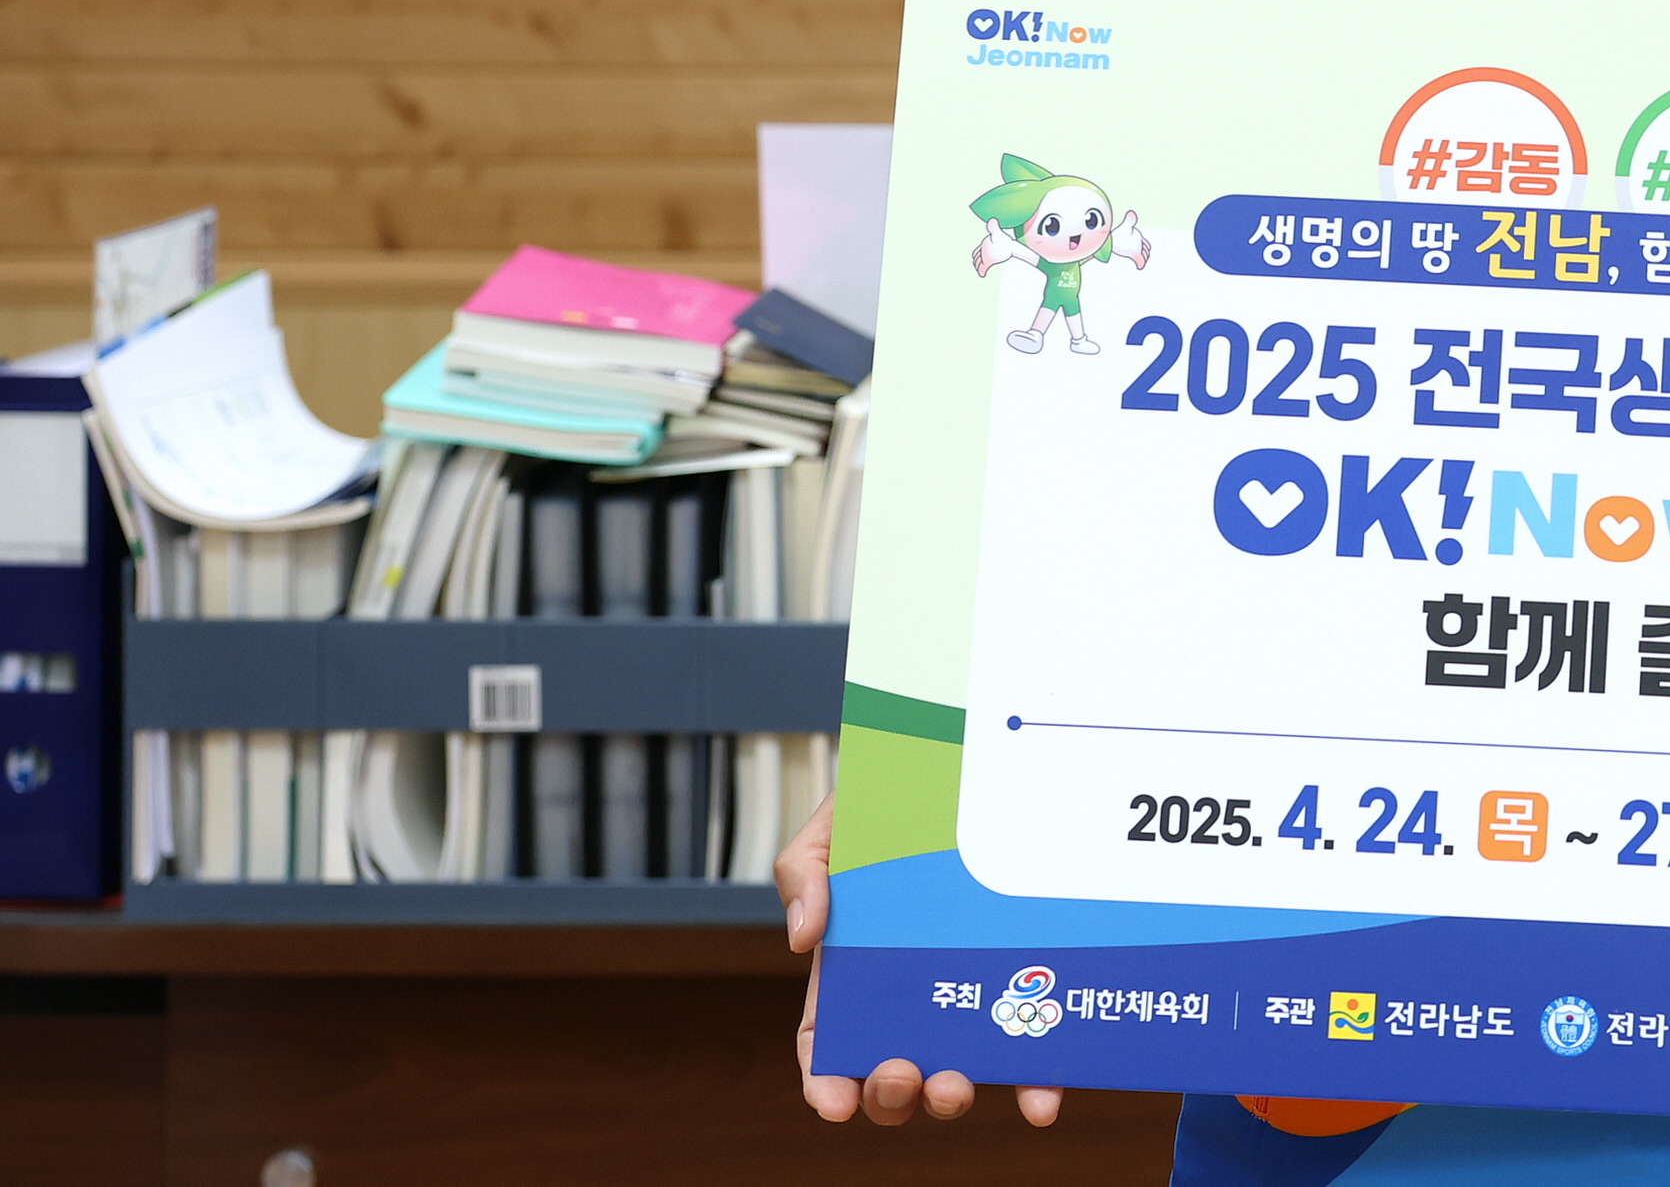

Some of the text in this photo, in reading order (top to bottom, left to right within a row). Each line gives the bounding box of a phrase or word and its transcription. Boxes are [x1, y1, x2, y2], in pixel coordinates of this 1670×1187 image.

[966, 8, 1112, 44] OK! Now
[966, 44, 1110, 70] Jeonnam
[1406, 139, 1561, 196] #감동
[1248, 214, 1392, 269] 생명의
[1411, 221, 1460, 274] 땅
[1475, 210, 1620, 286] 전남,
[1120, 315, 1378, 422] 2025
[1213, 447, 1476, 567] OK!
[1422, 592, 1611, 694] 함께
[1127, 793, 1263, 847] 2025.
[1277, 784, 1334, 850] 4.
[1355, 786, 1455, 856] 24.
[1489, 798, 1539, 856] 목
[931, 980, 983, 1011] 주최
[1065, 988, 1210, 1026] 대한체육회
[1263, 997, 1316, 1027] 주관
[1384, 1000, 1515, 1040] 전라남도
